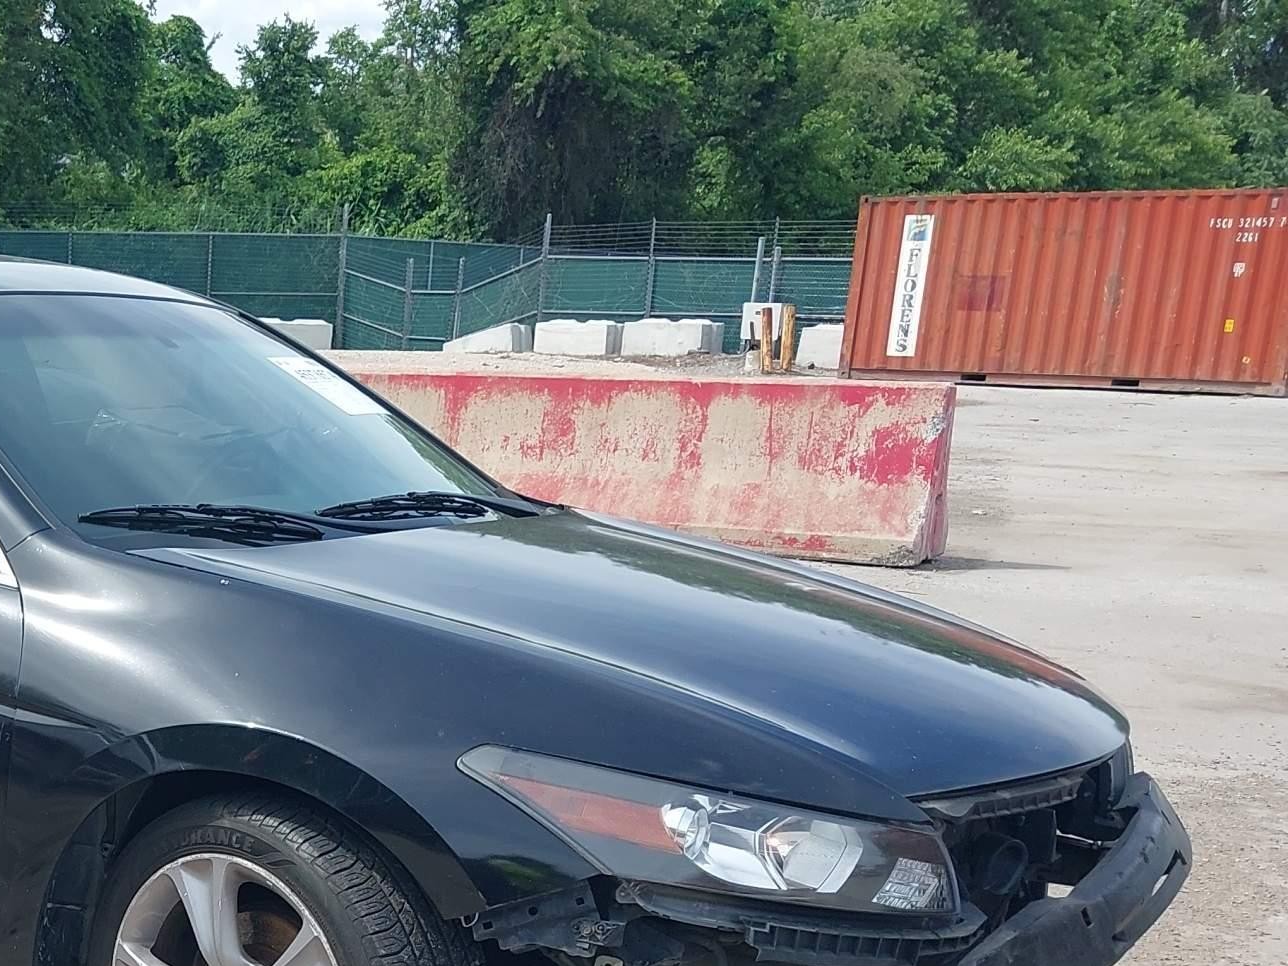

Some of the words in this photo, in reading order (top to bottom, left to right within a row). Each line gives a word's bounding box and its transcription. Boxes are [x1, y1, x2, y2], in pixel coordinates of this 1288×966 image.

[1209, 218, 1233, 229] FSCU
[1238, 217, 1274, 228] 321457
[1235, 232, 1258, 242] 2261
[894, 248, 921, 353] FLORENS
